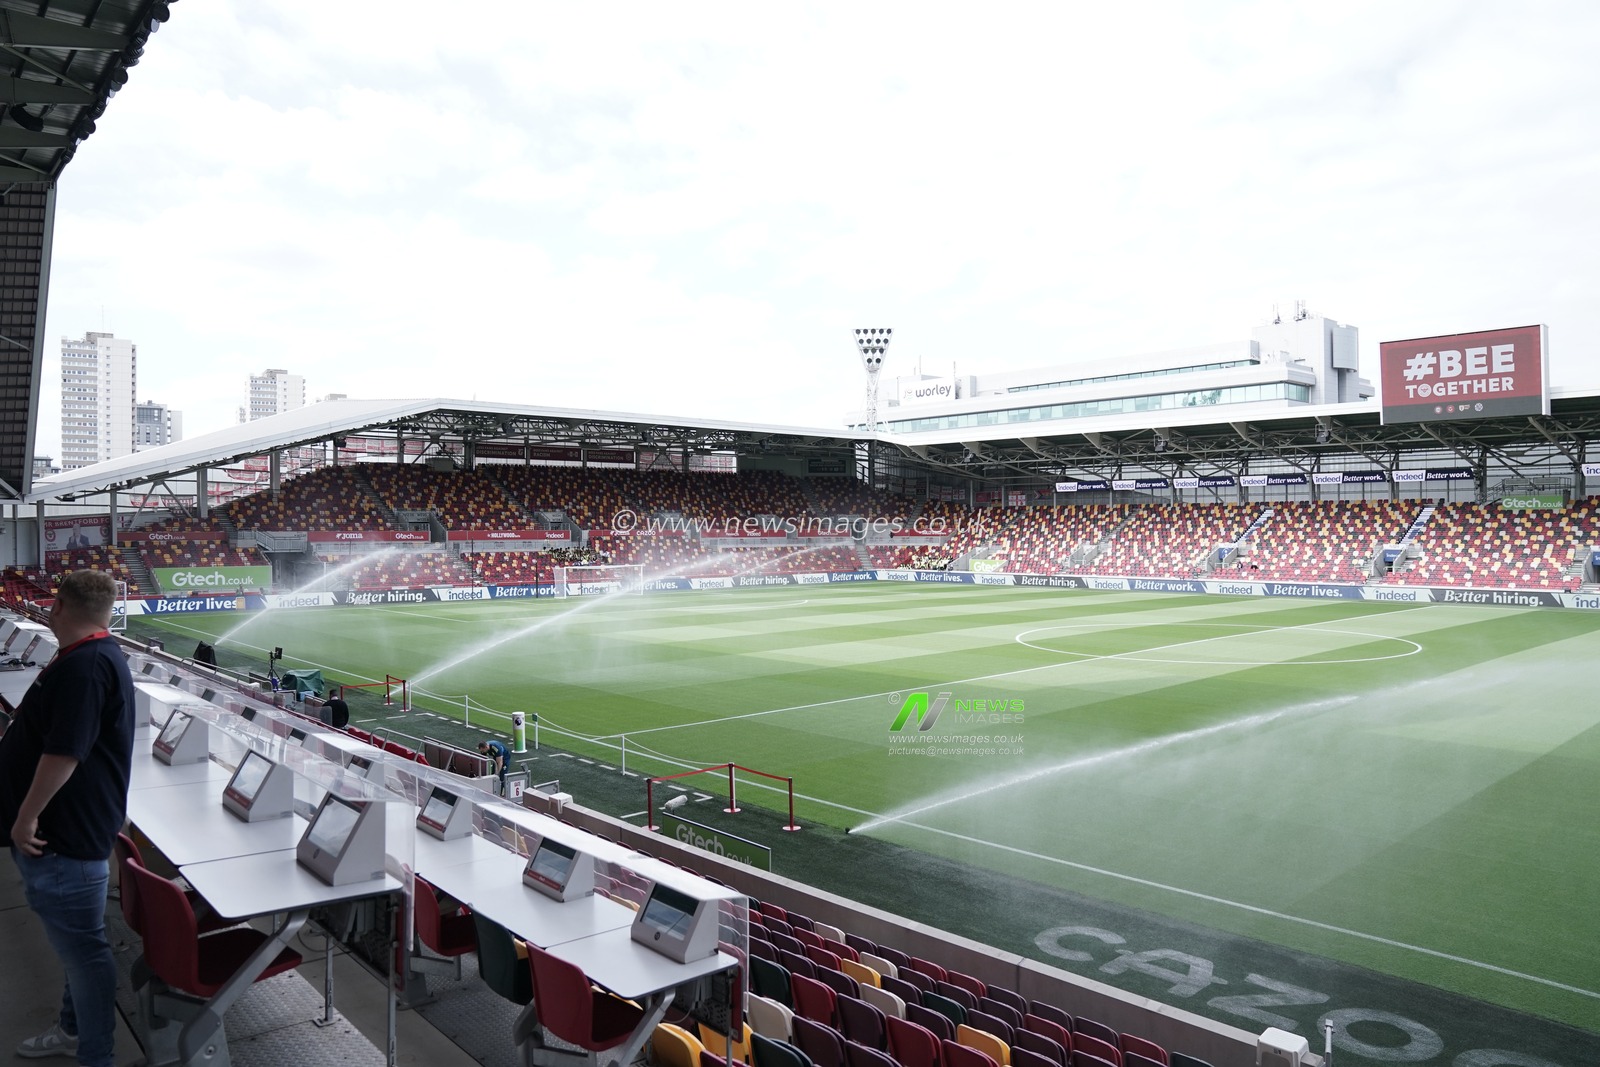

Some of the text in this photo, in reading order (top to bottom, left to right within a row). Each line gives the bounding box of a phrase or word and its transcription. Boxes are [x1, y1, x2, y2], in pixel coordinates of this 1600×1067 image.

[1403, 344, 1515, 382] #BEE
[915, 384, 952, 397] worley
[1405, 376, 1515, 399] TOGETHER
[1315, 473, 1341, 483] indeed
[1343, 474, 1363, 482] Better
[1395, 470, 1424, 480] indeed
[1426, 471, 1448, 480] Better
[1114, 481, 1135, 489] indeed
[1136, 481, 1151, 489] Better
[1175, 478, 1198, 488] indeed
[1199, 479, 1216, 487] Better
[1242, 476, 1266, 486] indeed
[1268, 477, 1286, 485] Better
[1057, 483, 1077, 491] indeed
[1078, 483, 1092, 491] Better
[1502, 498, 1563, 509] Gtech.co.uk
[54, 518, 99, 527] BRENTFORD
[172, 571, 254, 587] Gtech.co.uk
[740, 576, 790, 586] Better hiring.
[802, 574, 824, 584] indeed
[832, 572, 872, 582] Better work.
[887, 572, 908, 580] indeed
[920, 572, 962, 582] Better lives.
[981, 576, 1006, 584] indeed
[700, 579, 724, 589] indeed
[1021, 576, 1078, 588] Better hiring.
[1094, 580, 1124, 590] indeed
[1134, 580, 1197, 592] Better work.
[495, 586, 528, 597] Better
[1218, 584, 1252, 594] indeed
[1273, 584, 1343, 598] Better lives.
[346, 590, 427, 604] Better hiring.
[448, 589, 482, 600] indeed
[1375, 590, 1416, 600] indeed
[1444, 590, 1544, 606] Better hiring.
[156, 598, 204, 612] Better
[516, 787, 520, 797] 6
[1033, 926, 1566, 1067] CAZO
